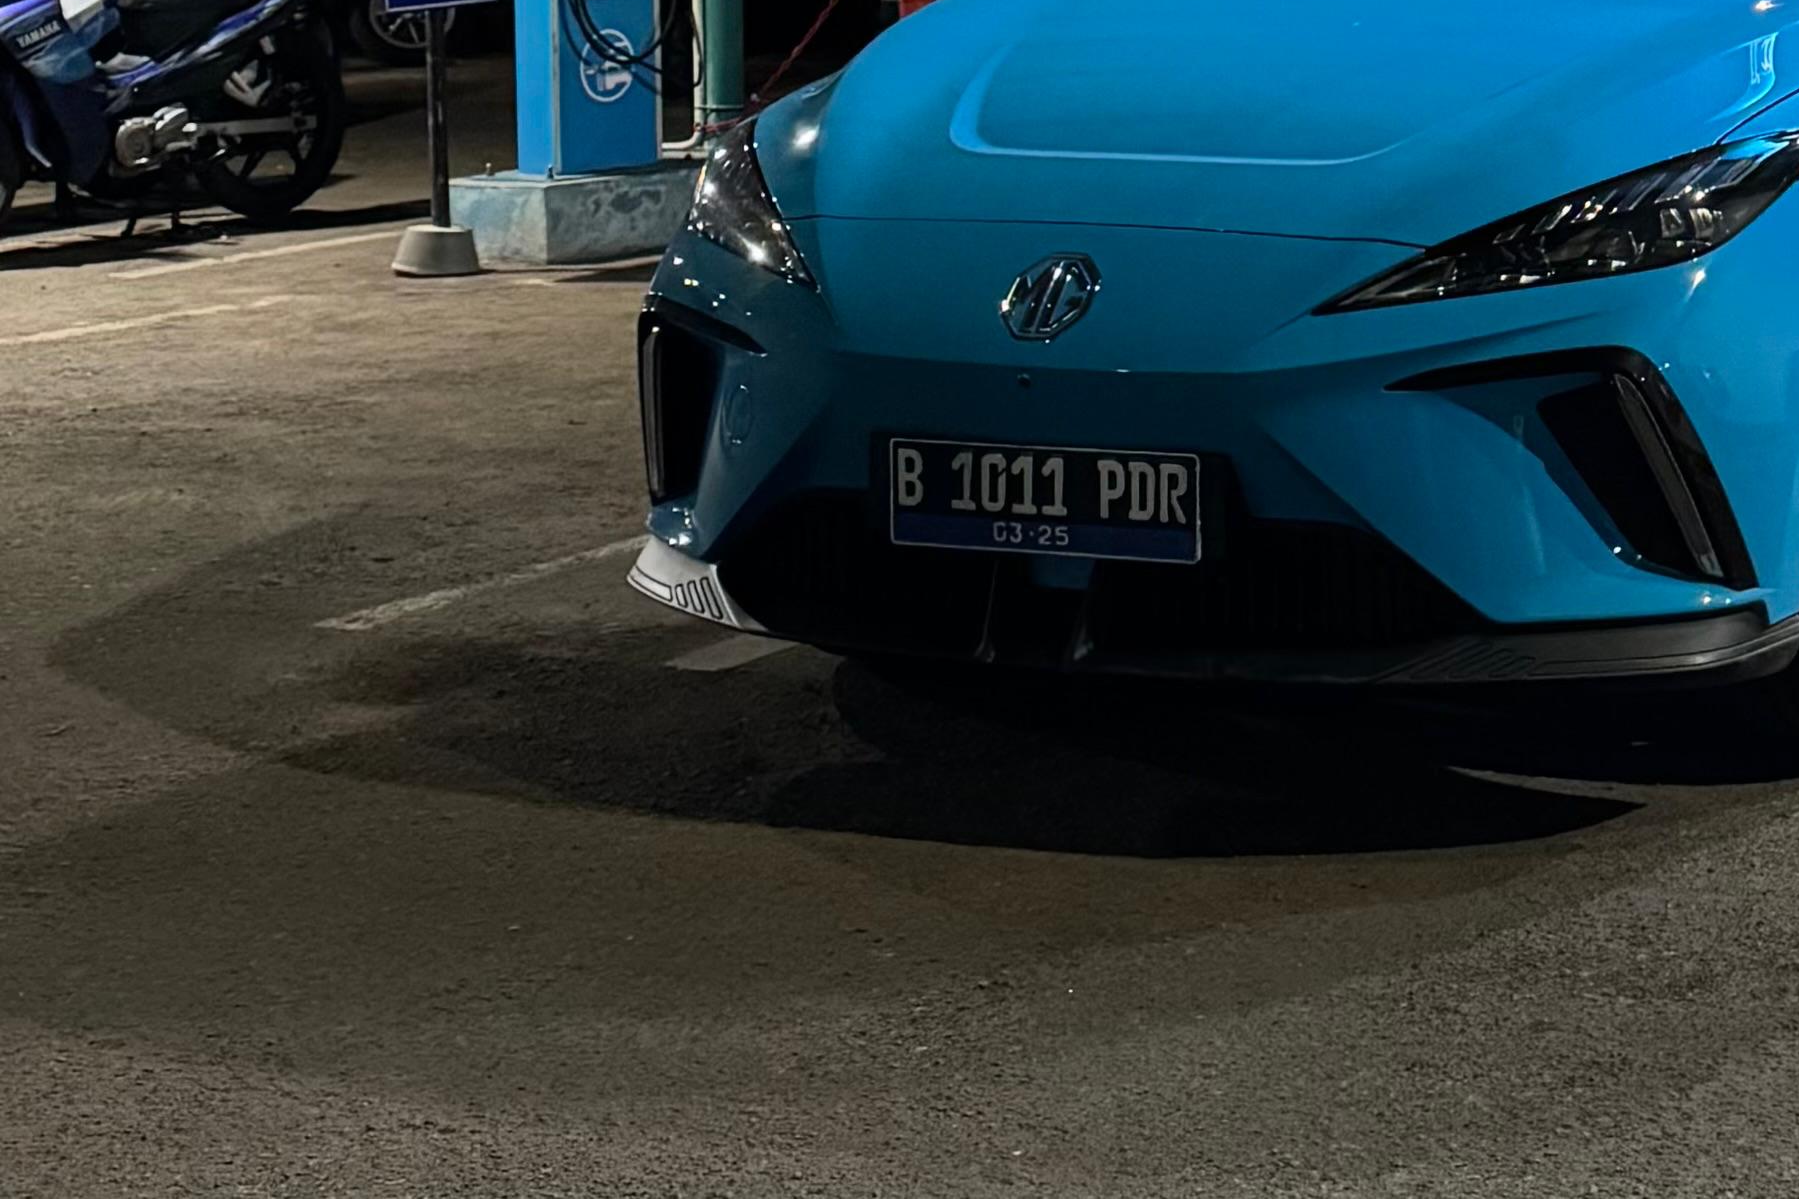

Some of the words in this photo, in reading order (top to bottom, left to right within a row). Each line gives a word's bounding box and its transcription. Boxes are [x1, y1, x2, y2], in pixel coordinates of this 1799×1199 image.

[16, 20, 61, 48] YAMAHA
[898, 448, 924, 507] B
[951, 451, 1069, 517] 1011
[1097, 459, 1189, 525] PDR
